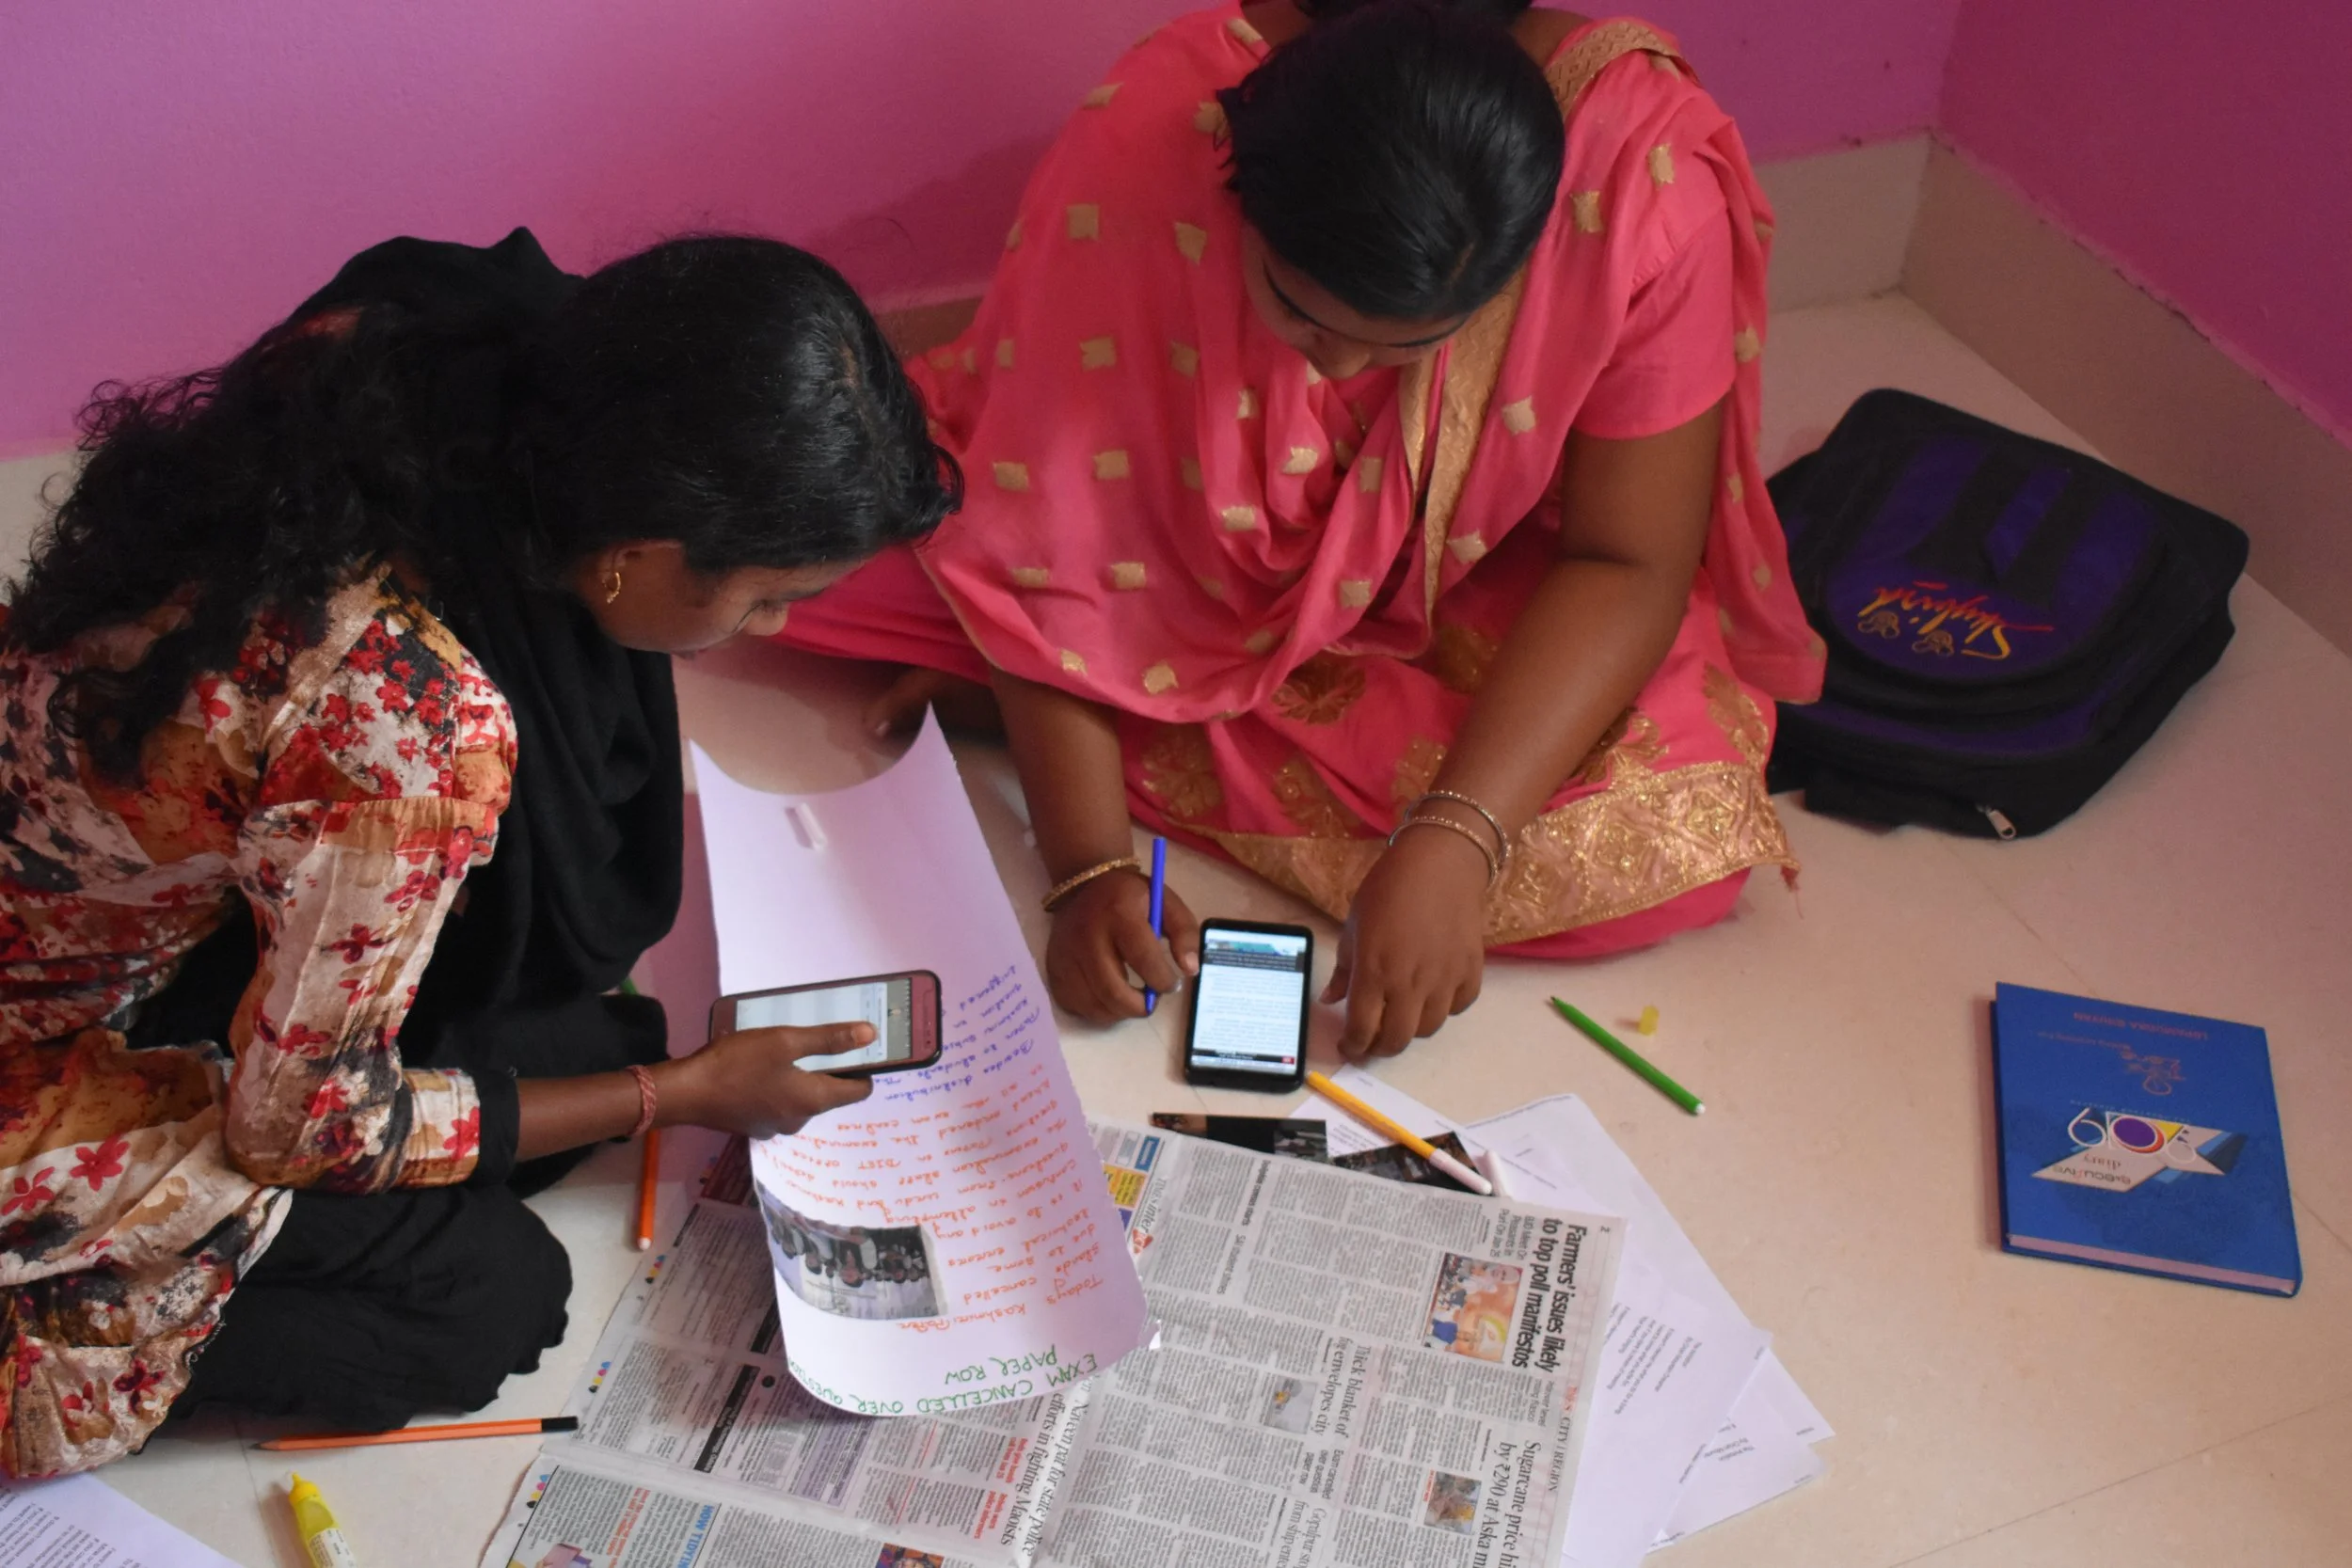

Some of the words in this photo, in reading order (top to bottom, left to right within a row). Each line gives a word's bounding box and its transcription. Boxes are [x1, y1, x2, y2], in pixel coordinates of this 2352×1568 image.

[2083, 1152, 2121, 1170] diary
[1542, 1218, 1563, 1237] to
[1532, 1235, 1557, 1263] top
[1553, 1225, 1587, 1290] Farmers'
[963, 1276, 1037, 1305] cancelled
[1527, 1263, 1551, 1291] poll
[1545, 1290, 1575, 1334] issues
[1334, 1337, 1353, 1350] fog
[1512, 1293, 1546, 1368] manifestos
[989, 1344, 1057, 1376] PAPER
[1351, 1346, 1371, 1375] Thick
[1534, 1334, 1565, 1372] likely
[945, 1366, 986, 1385] ROW
[1046, 1354, 1098, 1388] EXAM
[1321, 1351, 1343, 1411] envelopes
[849, 1394, 906, 1414] OVER
[916, 1380, 1034, 1414] CANCELLED
[1339, 1379, 1363, 1421] blanket
[1042, 1393, 1065, 1433] efforts
[1058, 1400, 1089, 1445] Naveen
[1311, 1415, 1330, 1435] city
[1037, 1433, 1054, 1447] in
[1335, 1423, 1348, 1438] of
[1558, 1417, 1570, 1443] CITY
[1050, 1444, 1071, 1468] pat
[1304, 1452, 1314, 1471] paper
[1319, 1450, 1328, 1465] over
[1331, 1449, 1343, 1467] Exam
[1494, 1442, 1516, 1461] by
[1016, 1447, 1047, 1497] fighting
[1046, 1467, 1066, 1487] for
[1299, 1473, 1308, 1484] row
[1310, 1465, 1324, 1493] question
[1322, 1468, 1336, 1499] cancelled
[1490, 1464, 1510, 1497] ₹290
[1512, 1441, 1541, 1512] Sugarcane
[1548, 1451, 1564, 1493] REGION
[1033, 1486, 1057, 1517] state
[1290, 1500, 1309, 1523] from
[1486, 1498, 1500, 1513] at
[696, 1505, 715, 1530] HOW
[1001, 1497, 1030, 1545] Maoists
[1302, 1509, 1326, 1553] Gopalpur
[1478, 1515, 1499, 1549] Aska
[1503, 1513, 1522, 1550] price
[1019, 1515, 1045, 1559] police
[1281, 1524, 1300, 1544] ship
